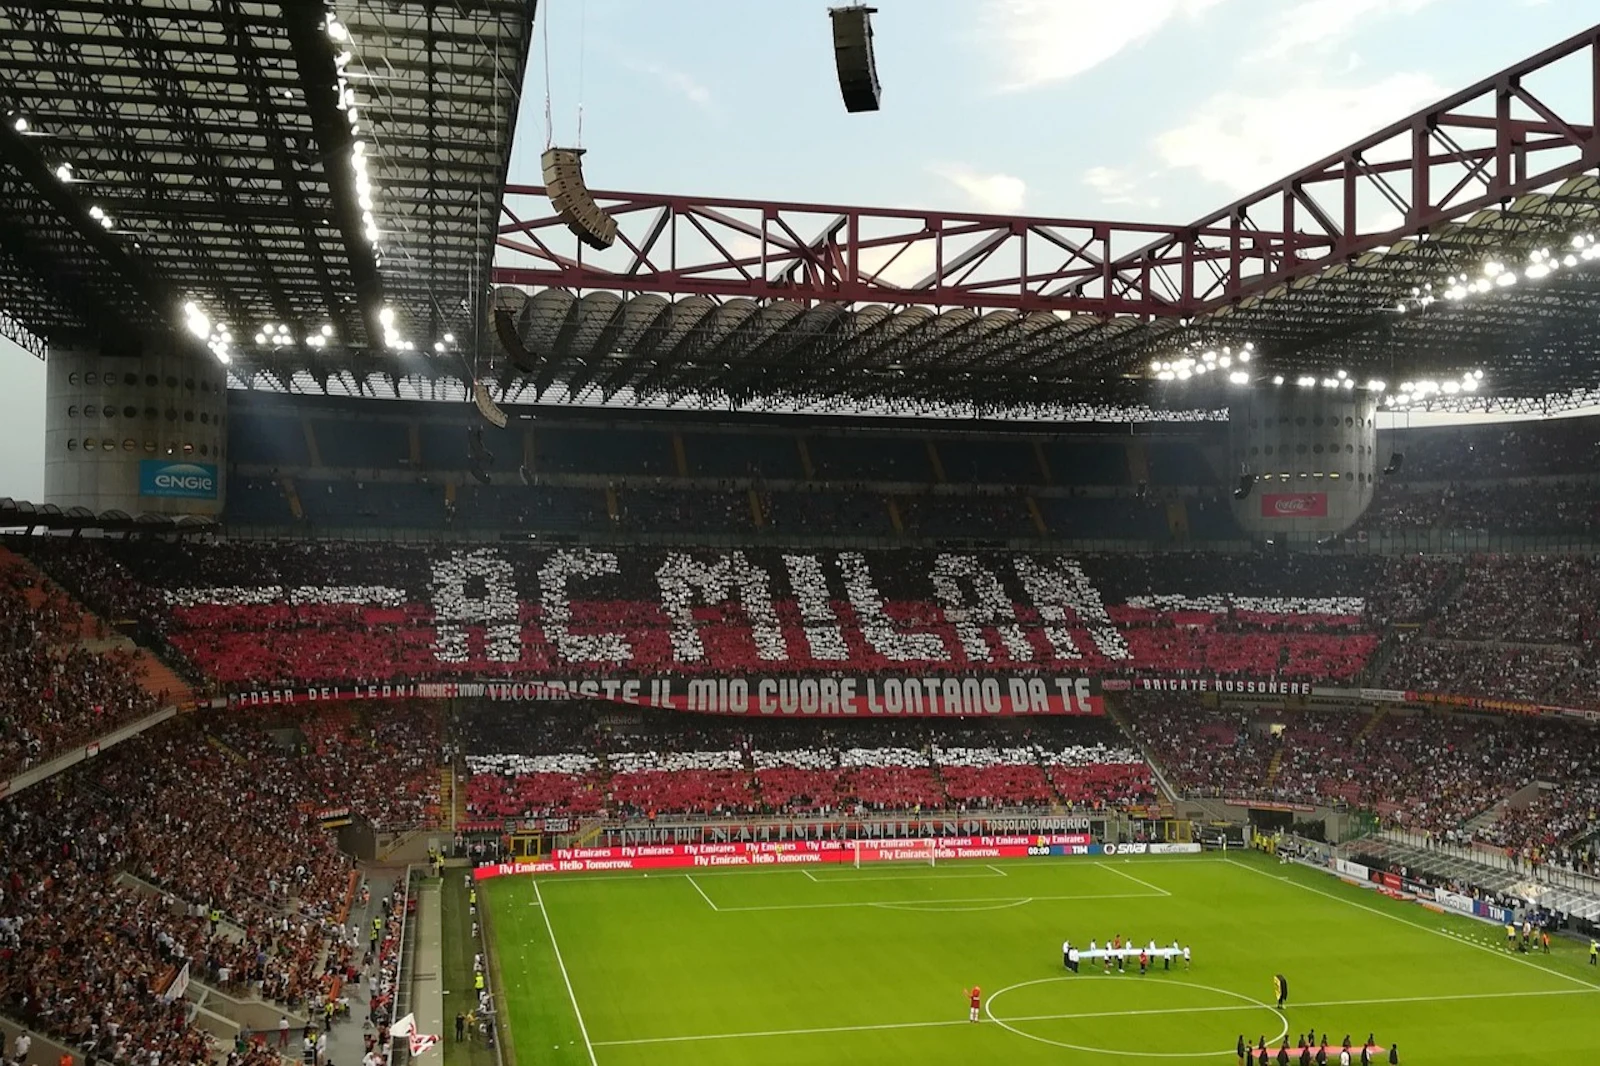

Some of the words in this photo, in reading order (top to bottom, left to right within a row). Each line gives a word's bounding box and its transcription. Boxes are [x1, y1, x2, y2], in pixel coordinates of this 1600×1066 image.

[656, 550, 1135, 663] MILAN
[1143, 679, 1207, 691] BRIGATE
[1215, 680, 1310, 694] ROSSONERE
[240, 689, 293, 706] FOSSA
[309, 686, 340, 701] DEI
[354, 684, 413, 698] LEONI
[651, 679, 675, 710] IL
[688, 678, 749, 713] MIO
[758, 678, 857, 715] CUORE
[866, 677, 1001, 715] LONTANO
[1008, 678, 1050, 713] DA
[1055, 678, 1092, 713] TE
[939, 837, 972, 846] Emirates
[981, 836, 994, 846] Fly
[996, 835, 1029, 844] Emirates
[1052, 834, 1085, 844] Emirates
[622, 847, 635, 857] Fly
[638, 846, 674, 855] Emirates
[684, 846, 698, 855] Fly
[700, 844, 735, 853] Emirates
[745, 843, 759, 852] Fly
[1028, 846, 1050, 855] 00:00
[1072, 845, 1088, 855] TIM
[557, 849, 572, 859] Fly
[574, 848, 611, 858] Emirates
[880, 850, 893, 860] Fly
[935, 848, 955, 858] Hello
[694, 855, 708, 866] Fly
[752, 853, 774, 863] Hello
[499, 863, 513, 874] Fly
[560, 860, 583, 870] Hello
[1488, 905, 1505, 921] TIM
